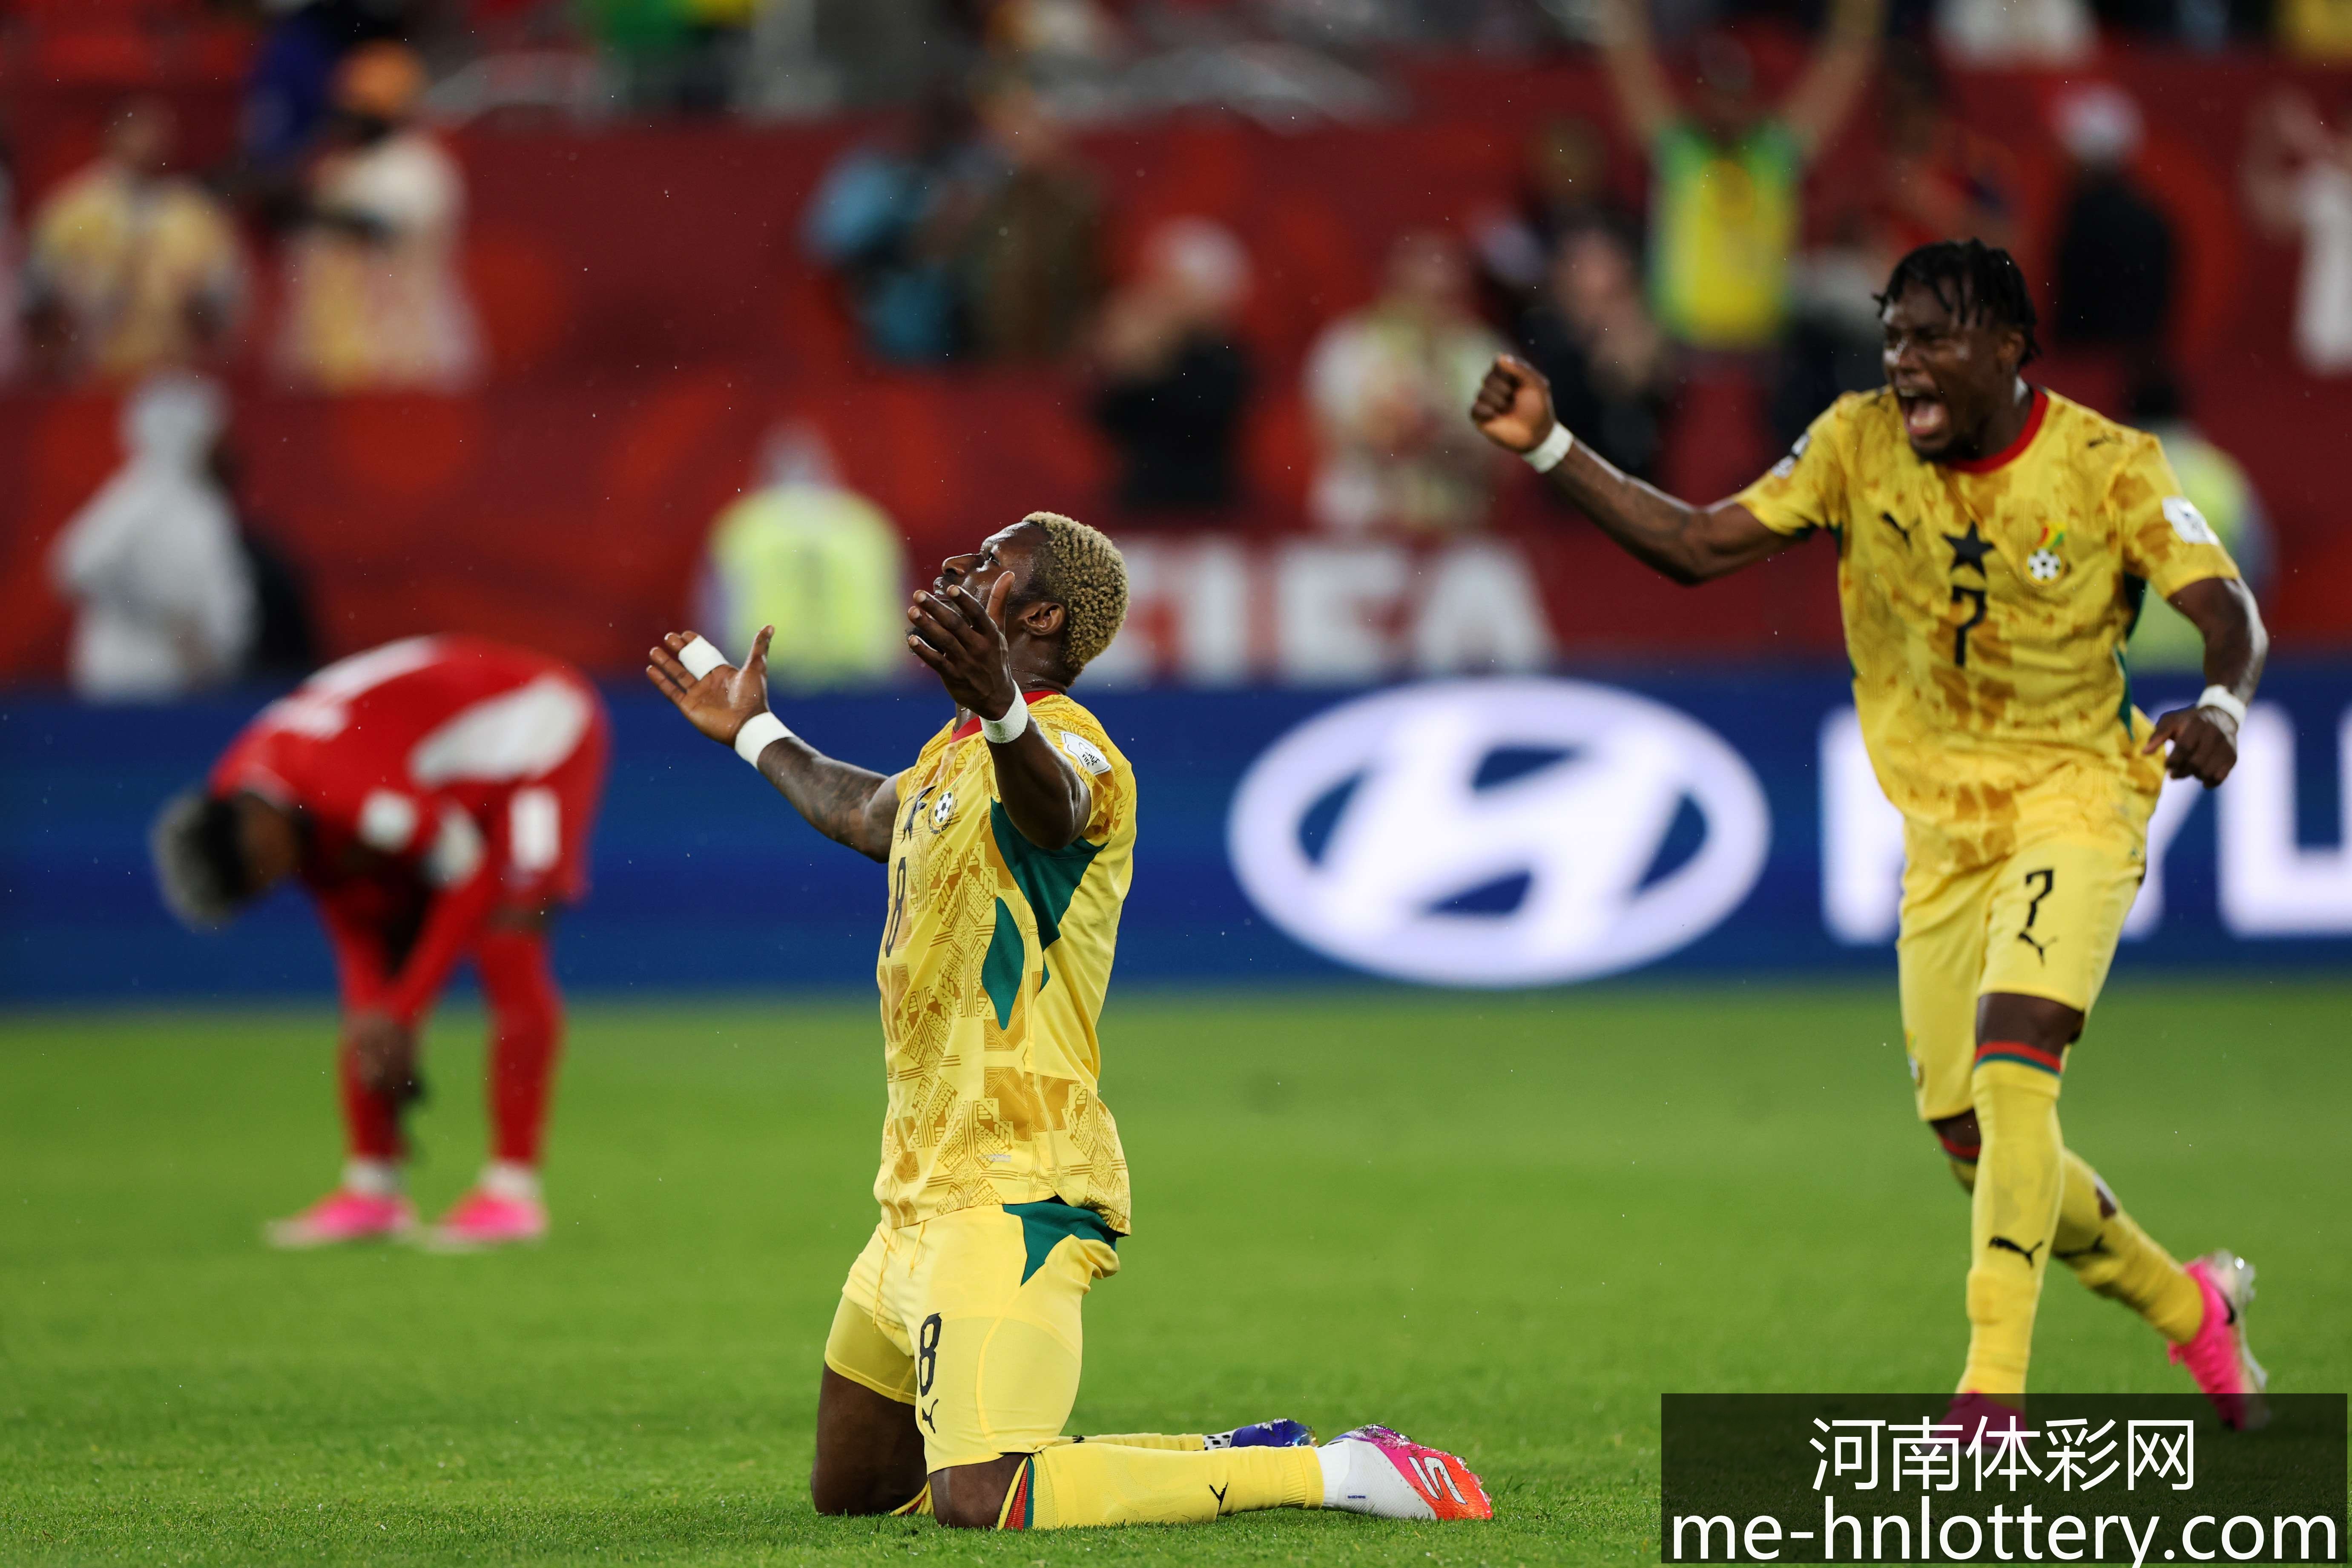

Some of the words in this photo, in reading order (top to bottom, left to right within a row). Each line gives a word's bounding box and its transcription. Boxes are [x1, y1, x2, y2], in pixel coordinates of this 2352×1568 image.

[1952, 585, 1986, 667] 7
[885, 857, 906, 958] 8
[2026, 869, 2053, 928] 7
[919, 1312, 942, 1398] 8
